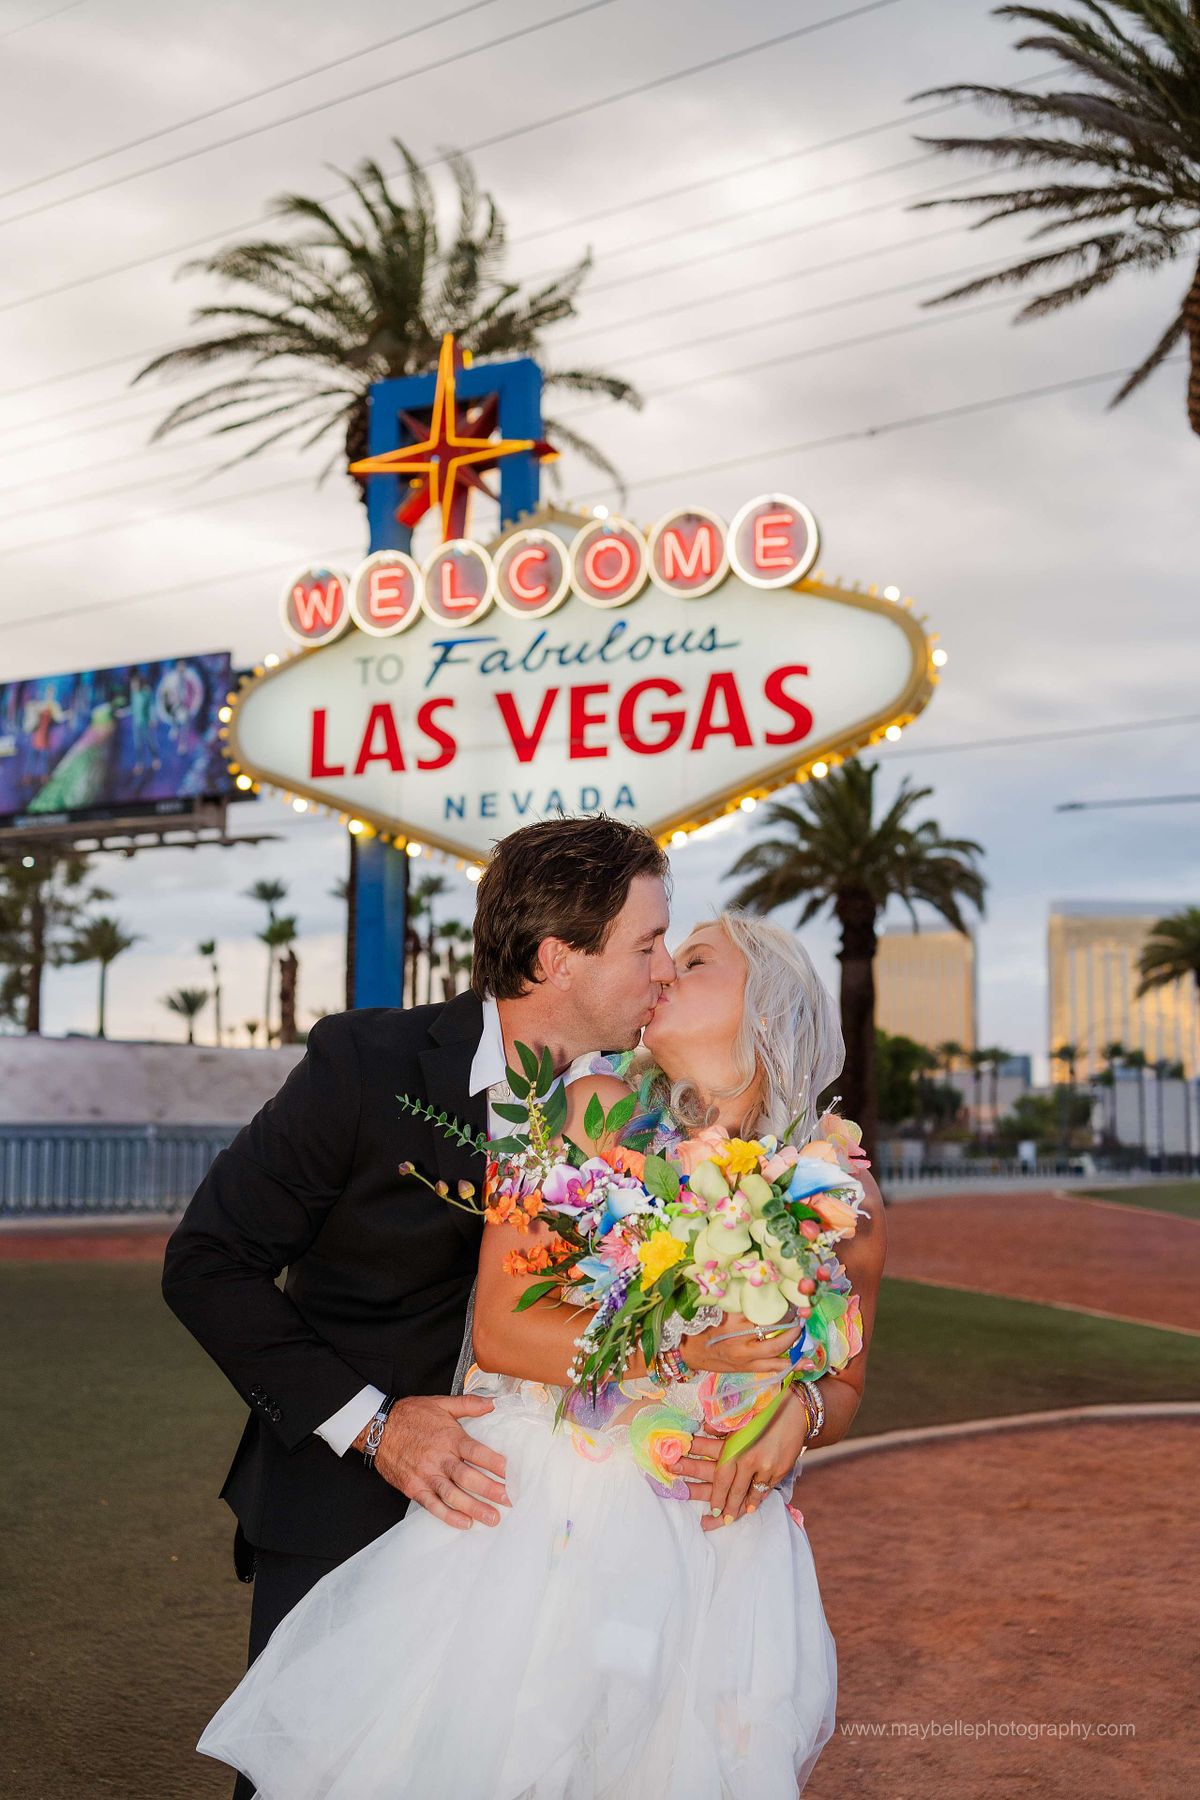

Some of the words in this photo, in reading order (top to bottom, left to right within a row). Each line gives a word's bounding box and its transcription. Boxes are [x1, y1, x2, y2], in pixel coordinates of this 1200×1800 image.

[293, 510, 797, 632] WELCOME
[357, 656, 402, 686] TO
[425, 621, 741, 687] Fabulous
[310, 697, 458, 778] LAS
[495, 664, 814, 763] VEGAS
[444, 784, 635, 820] NEVADA
